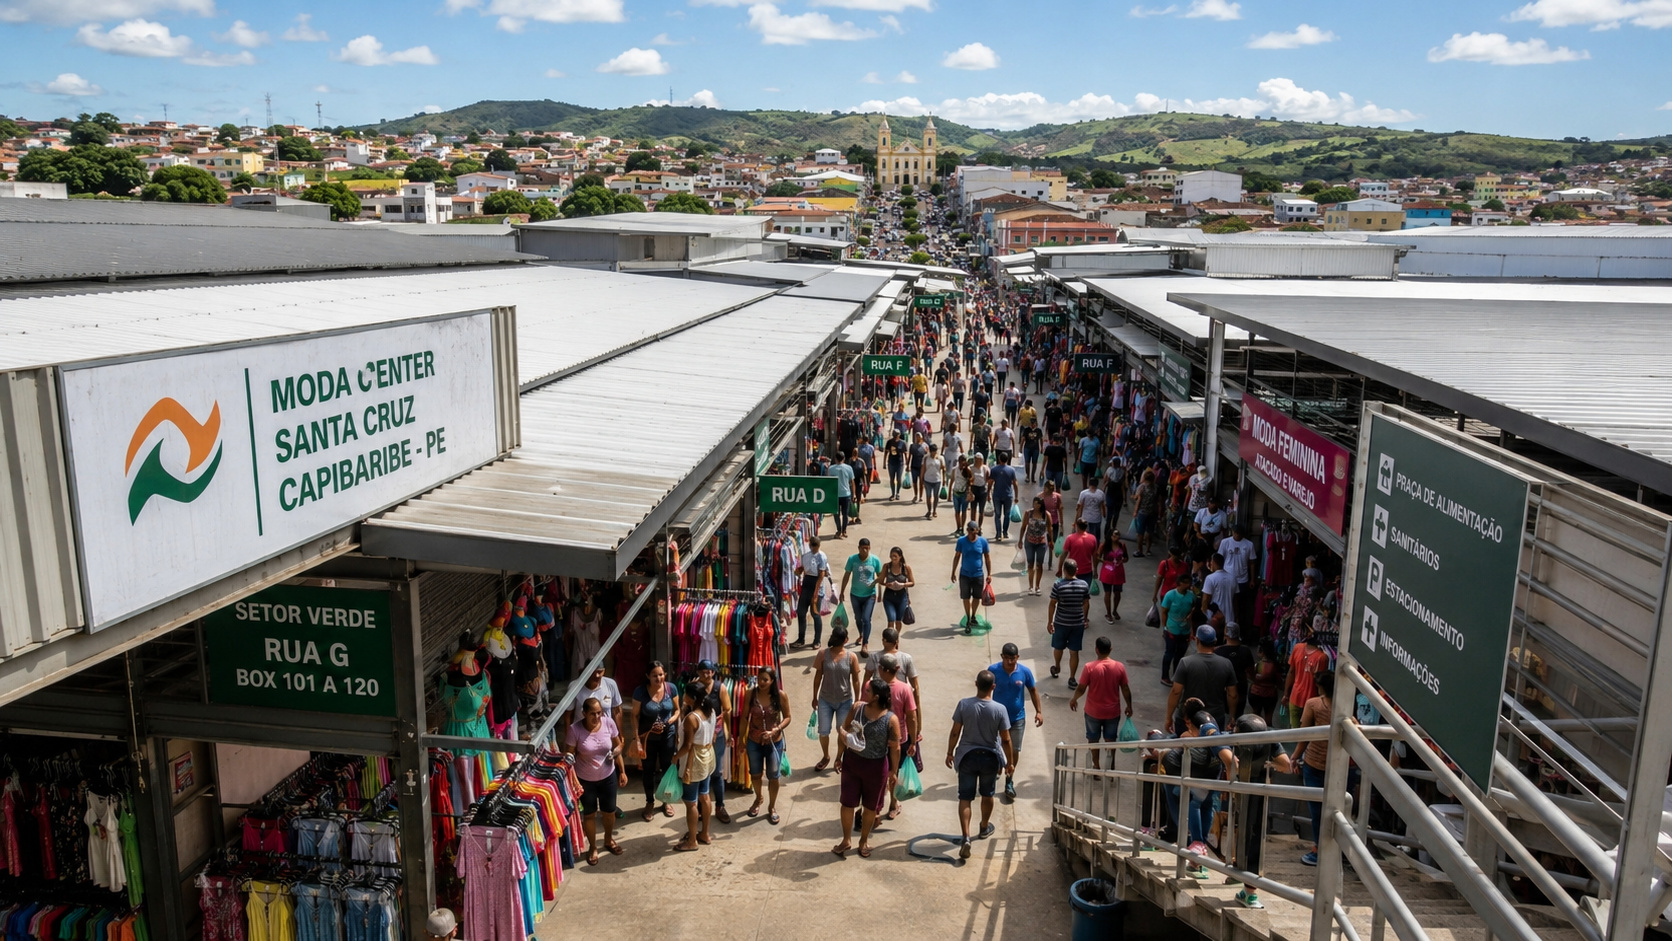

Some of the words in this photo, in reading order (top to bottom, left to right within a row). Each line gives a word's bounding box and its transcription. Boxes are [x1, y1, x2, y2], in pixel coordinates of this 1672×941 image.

[271, 367, 352, 413] MODA
[357, 350, 435, 392] CENTER
[871, 360, 893, 370] RUA
[896, 360, 903, 371] F
[1082, 358, 1104, 369] RUA
[1106, 359, 1113, 369] F
[275, 412, 358, 463] SANTA
[363, 395, 416, 436] CRUZ
[1252, 413, 1277, 452] MODA
[1278, 430, 1326, 485] FEMININA
[279, 438, 412, 512] CAPIBARIBE
[426, 427, 446, 458] PE
[772, 487, 808, 503] RUA
[813, 488, 826, 504] D
[1254, 452, 1282, 484] ATACADO
[1282, 472, 1288, 490] E
[1288, 478, 1315, 510] VAREJO
[1395, 472, 1422, 500] PRAÇA
[1423, 487, 1435, 507] DE
[1436, 494, 1503, 544] ALIMENTAÇÃO
[1390, 526, 1440, 571] SANITÁRIOS
[235, 602, 302, 624] SETOR
[307, 606, 376, 629] VERDE
[1385, 578, 1464, 651] ESTACIONAMENTO
[264, 637, 322, 665] RUA
[329, 643, 349, 667] G
[1380, 630, 1440, 696] INFORMAÇÕES
[236, 668, 277, 689] BOX
[283, 673, 315, 692] 101
[323, 676, 337, 694] A
[343, 677, 379, 697] 120
